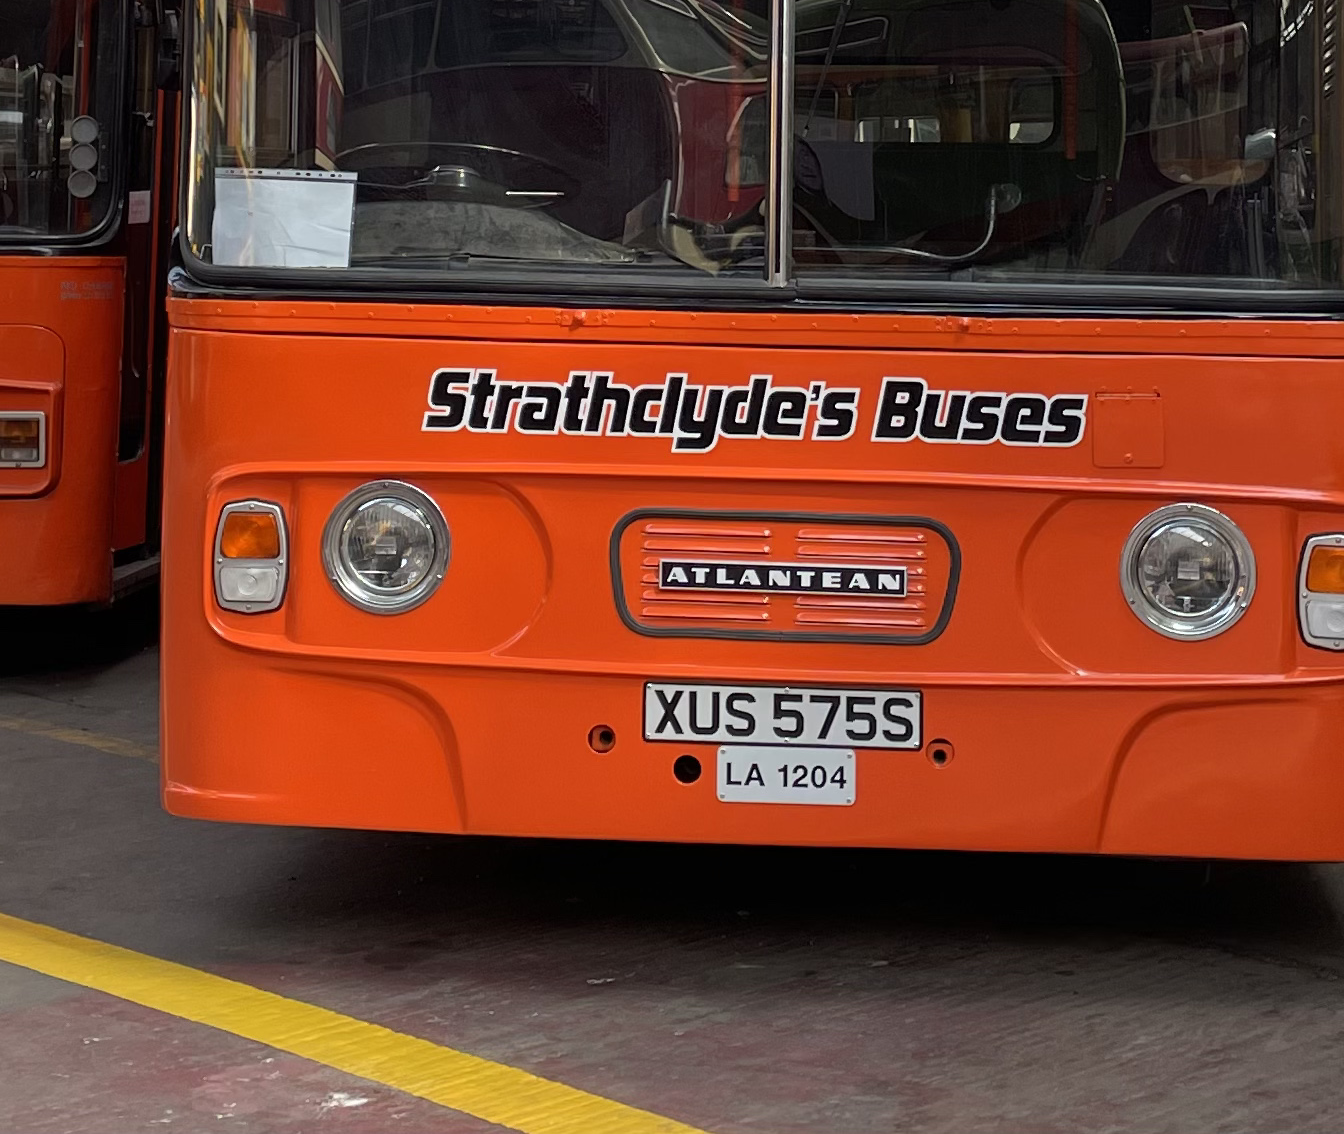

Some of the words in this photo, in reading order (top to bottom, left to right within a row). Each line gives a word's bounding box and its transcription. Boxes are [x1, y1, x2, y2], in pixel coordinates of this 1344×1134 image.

[421, 367, 861, 454] Strathclyde's
[870, 376, 1089, 449] Buses
[666, 566, 901, 591] ATLANTEAN
[654, 690, 757, 737] XUS
[772, 693, 914, 742] 575S
[725, 762, 766, 786] LA
[777, 764, 847, 789] 1204
